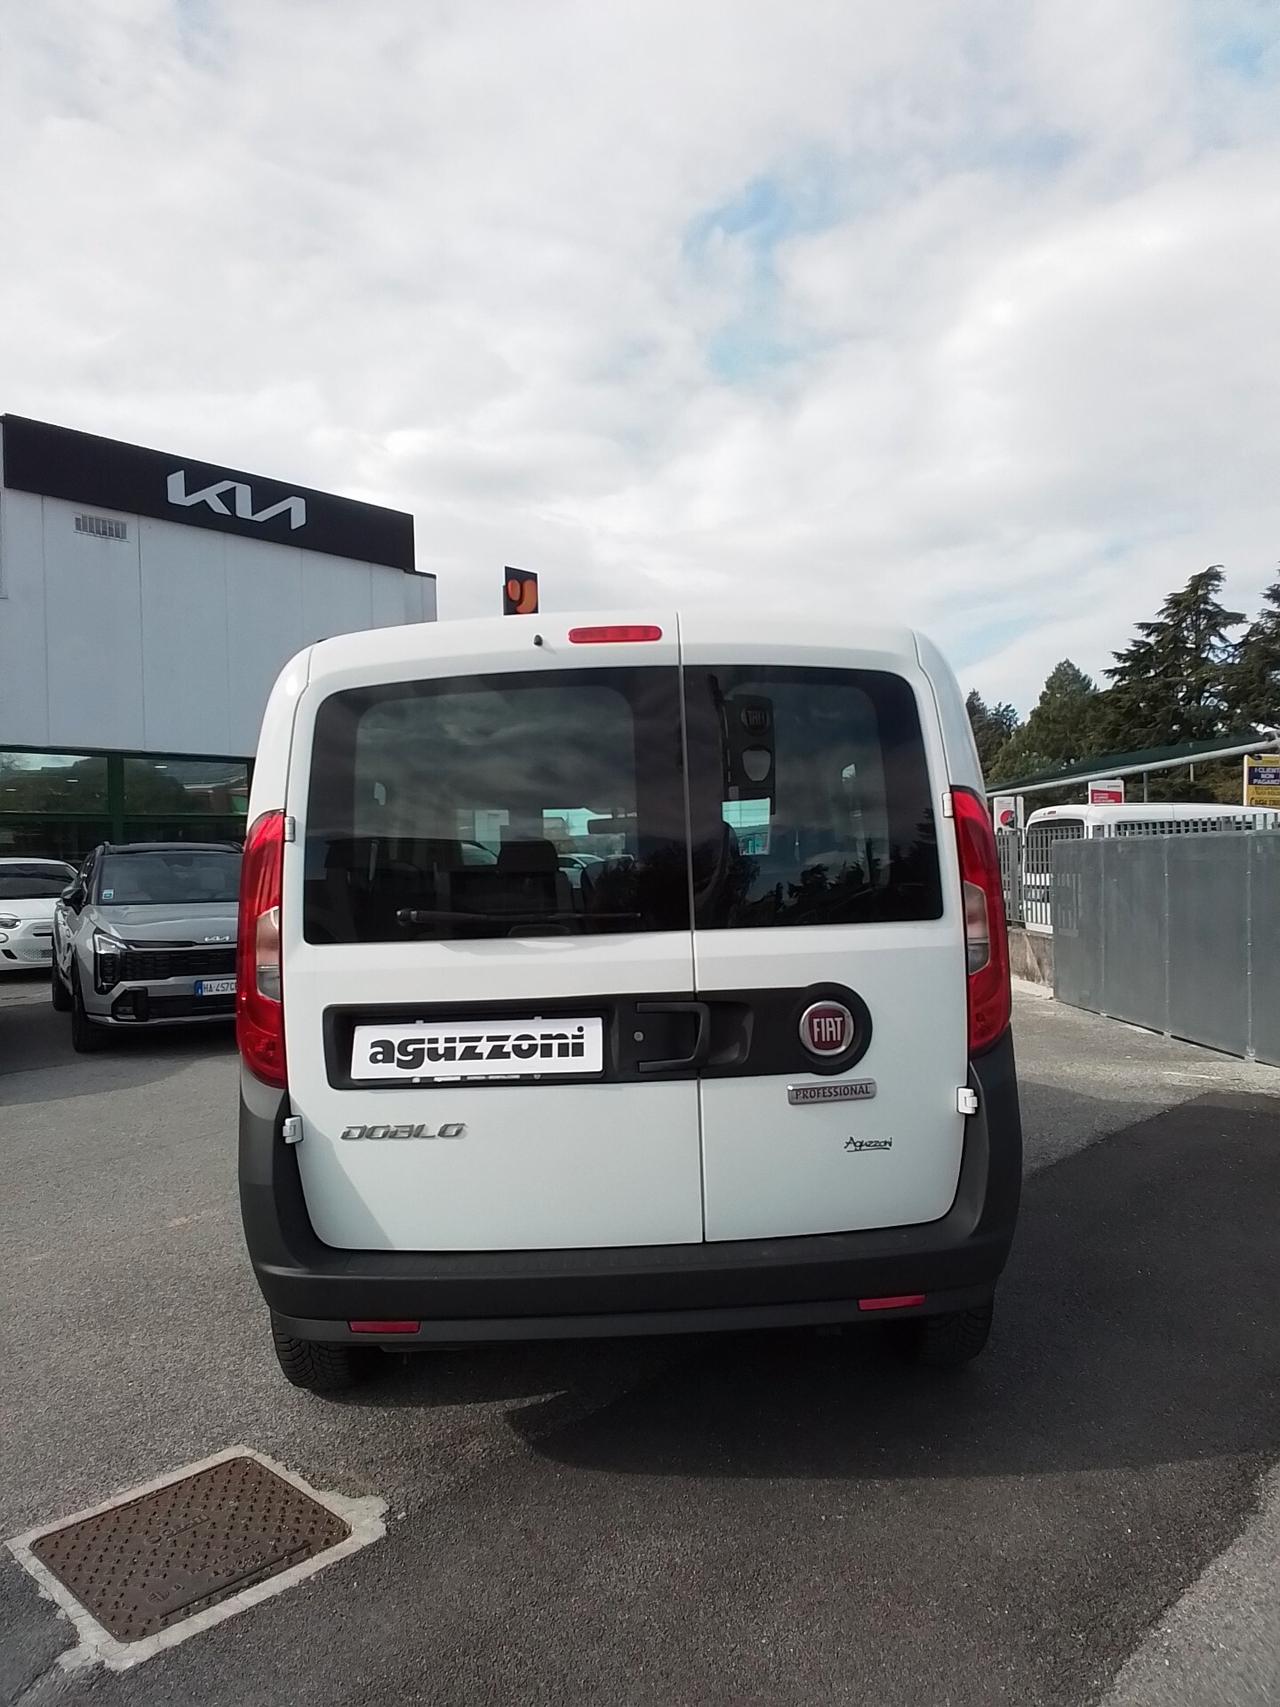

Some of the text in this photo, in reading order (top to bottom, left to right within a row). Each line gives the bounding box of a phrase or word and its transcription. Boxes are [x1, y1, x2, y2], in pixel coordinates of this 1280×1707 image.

[167, 470, 306, 530] KIA
[812, 1017, 843, 1043] FIAT
[369, 1026, 585, 1070] aguzzoni
[795, 1082, 871, 1100] PROFESSIONAL
